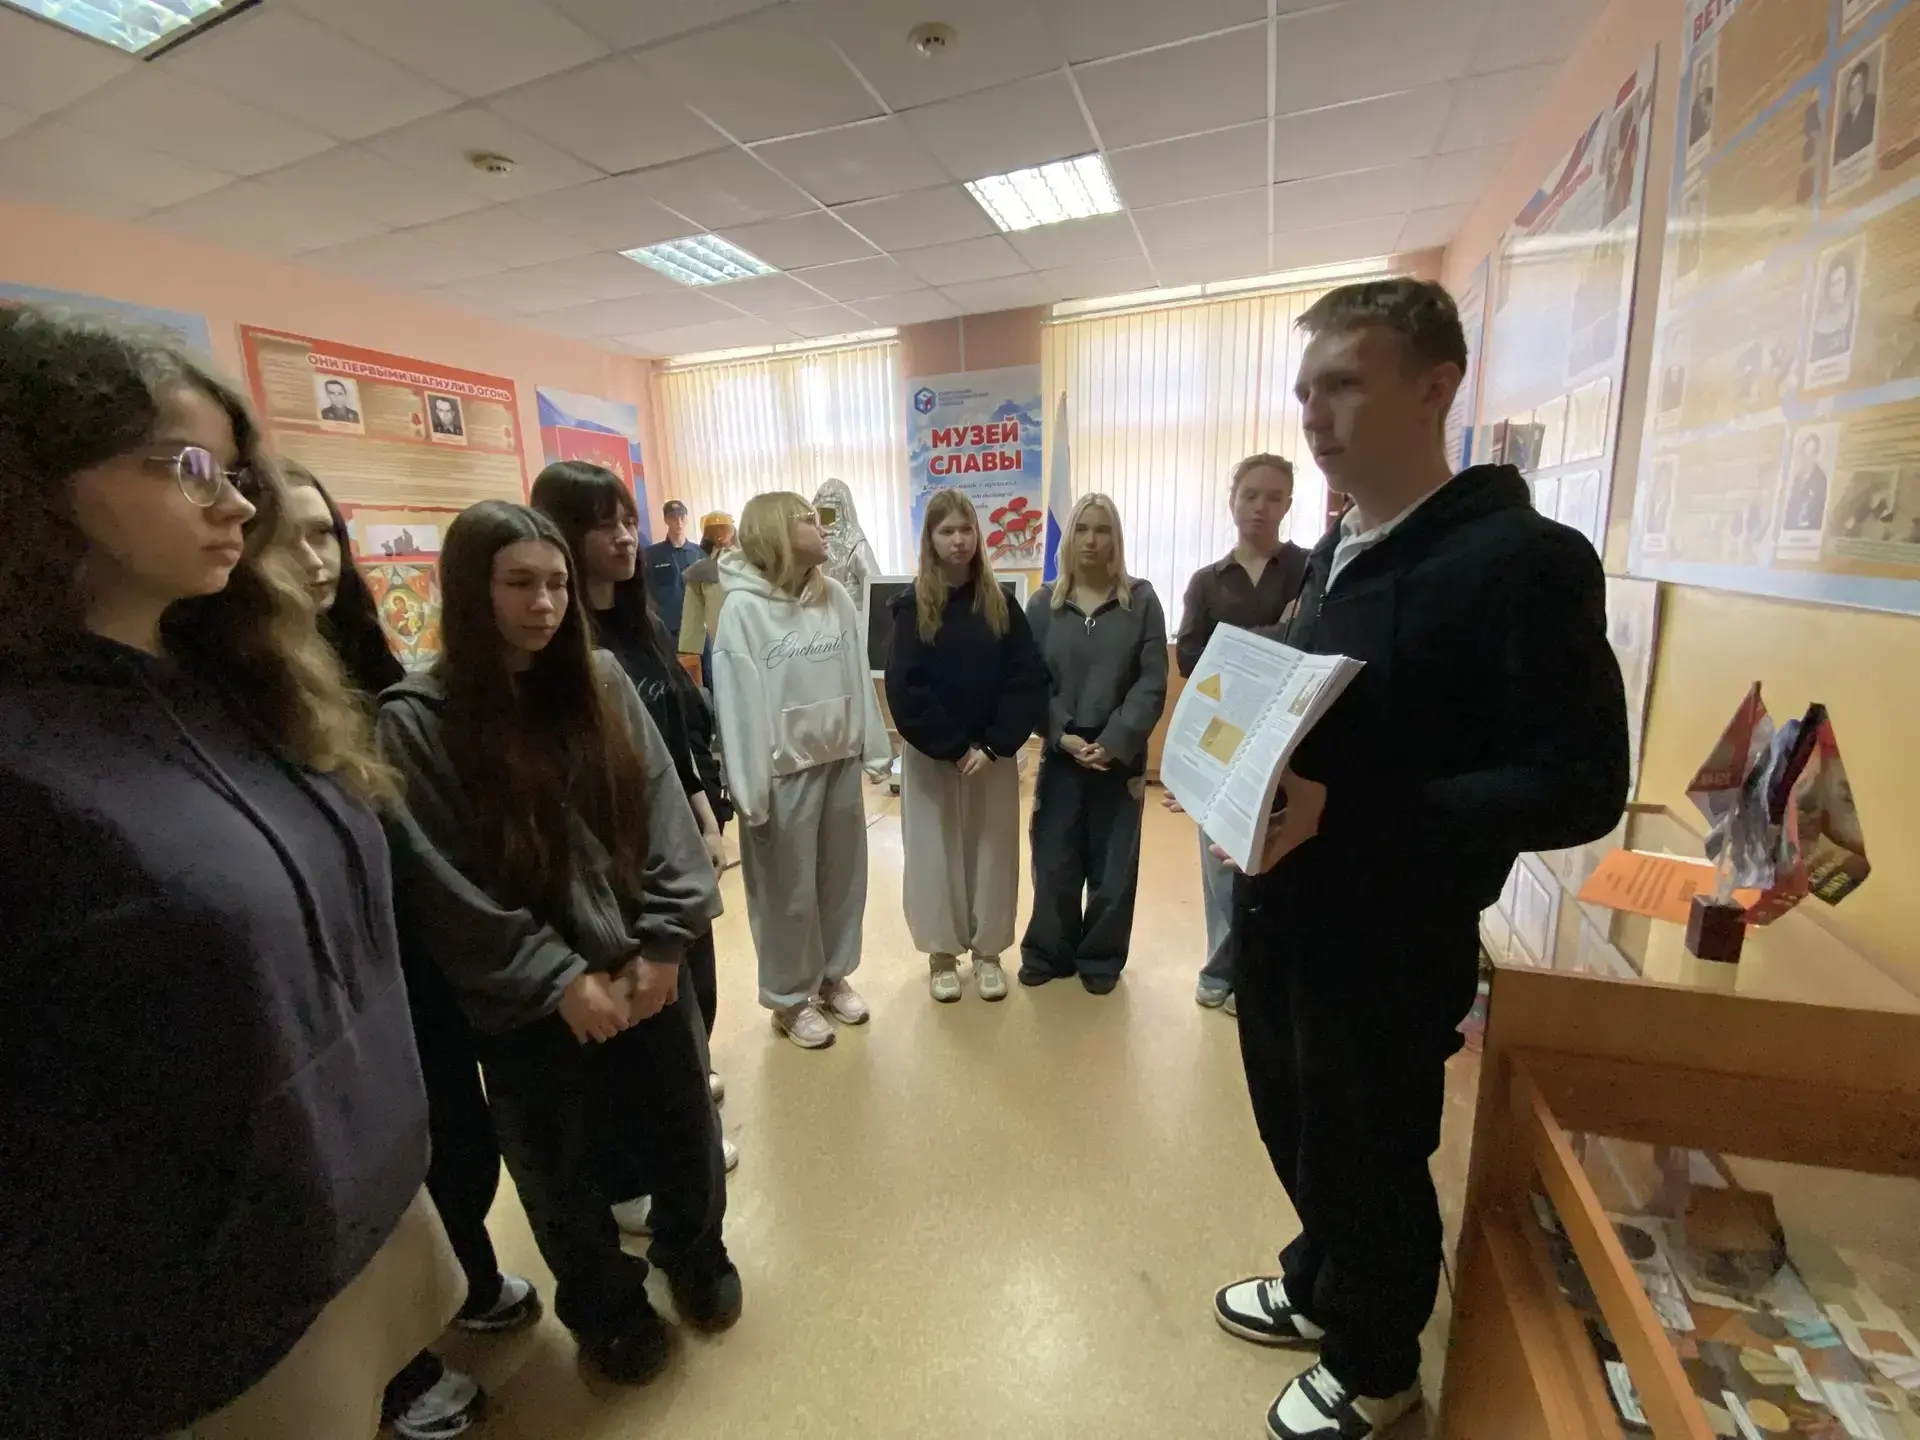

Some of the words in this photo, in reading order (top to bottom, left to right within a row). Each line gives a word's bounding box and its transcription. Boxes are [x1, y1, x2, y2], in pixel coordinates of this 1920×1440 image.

[307, 354, 340, 370] ОНИ
[342, 361, 408, 381] ПЕРВЫМИ
[410, 374, 466, 393] ШАГНУЛИ
[467, 384, 475, 394] В
[476, 386, 511, 400] ОГОНЬ
[931, 416, 1019, 449] МУЗЕЙ
[929, 449, 1022, 475] СЛАВЫ
